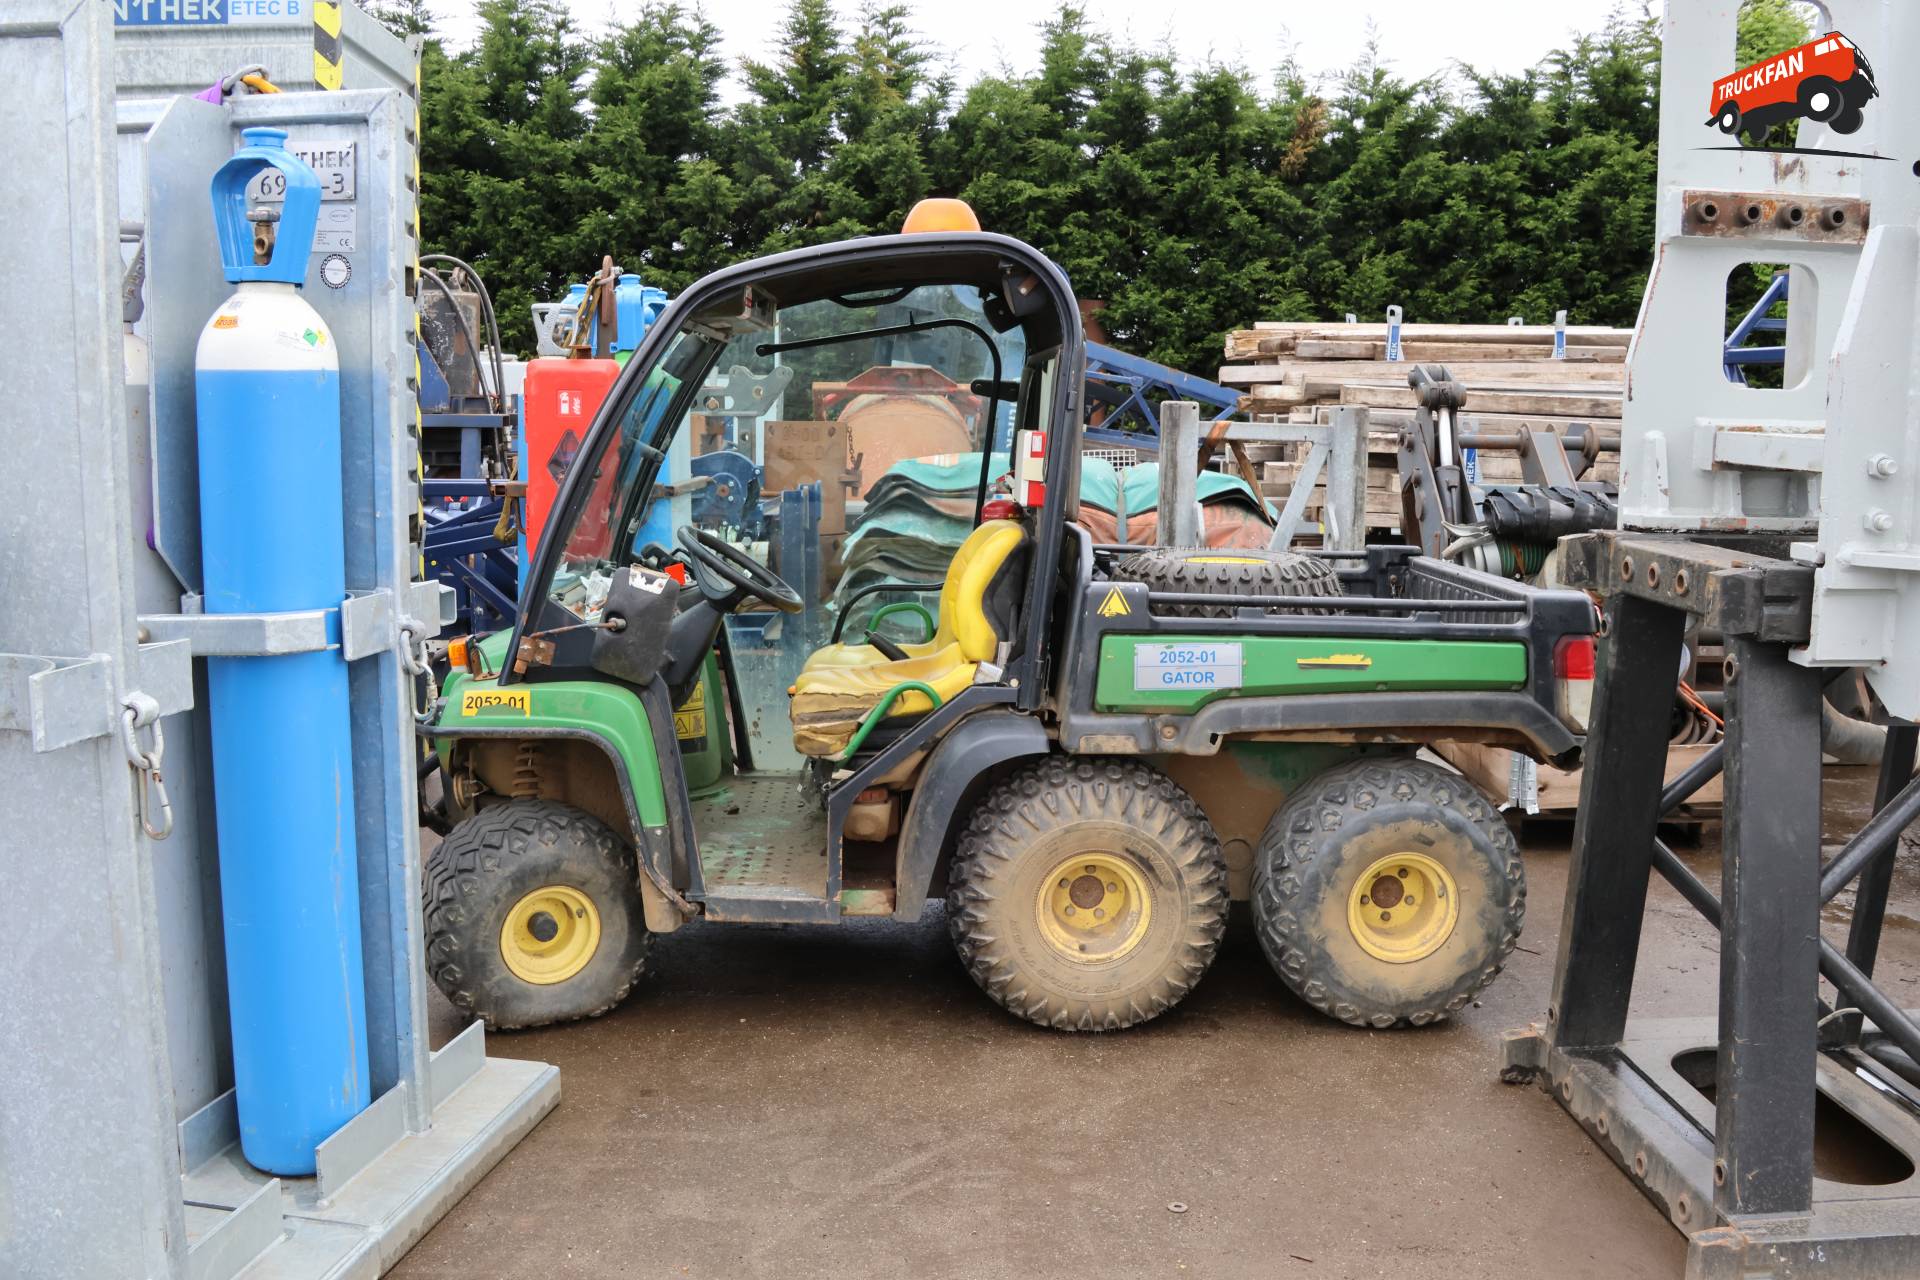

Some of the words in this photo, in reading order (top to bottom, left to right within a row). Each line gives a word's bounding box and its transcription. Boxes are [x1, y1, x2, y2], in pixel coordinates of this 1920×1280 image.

[232, 0, 281, 16] ETEC
[287, 0, 300, 15] B
[1159, 650, 1217, 664] 2052-01
[1162, 671, 1216, 684] GATOR
